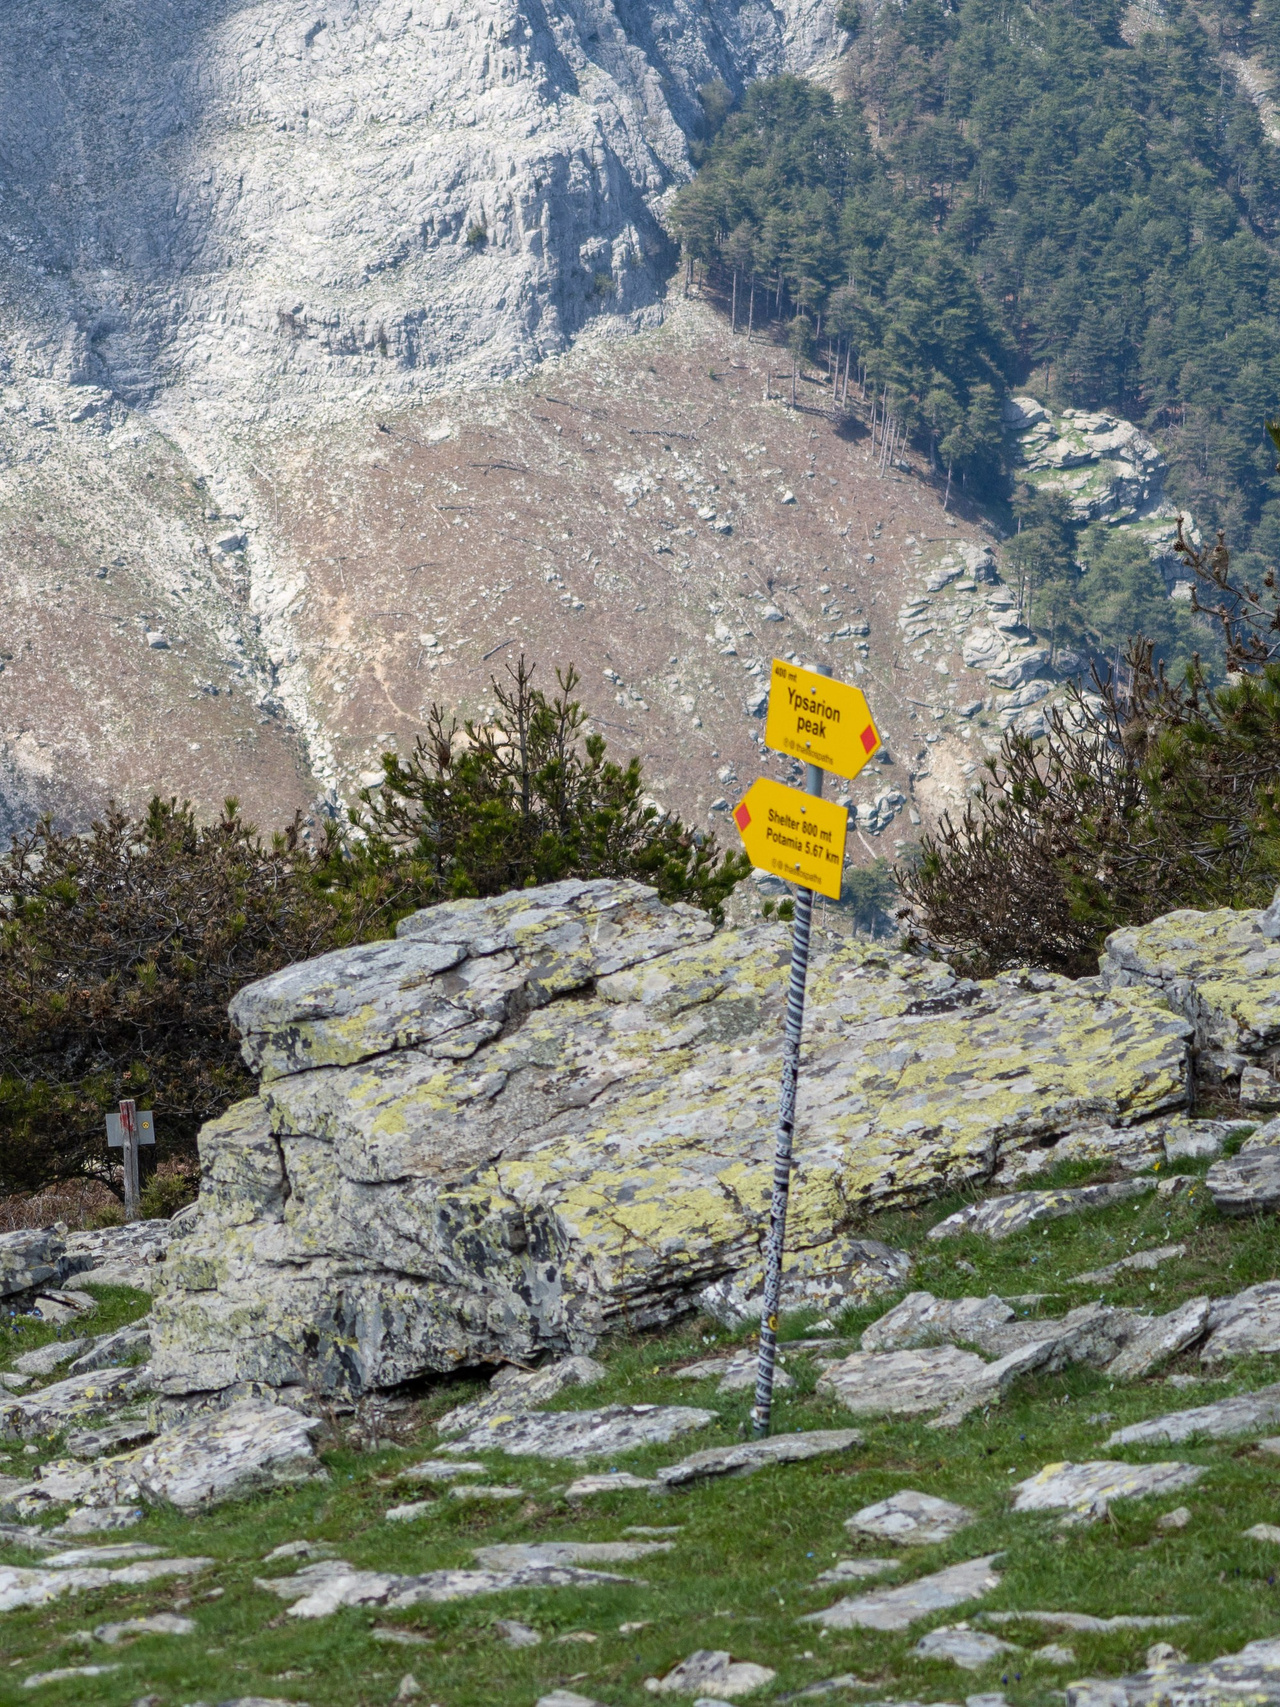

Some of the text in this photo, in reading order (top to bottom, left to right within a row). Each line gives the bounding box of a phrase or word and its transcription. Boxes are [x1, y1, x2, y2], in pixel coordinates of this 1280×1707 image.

[788, 687, 840, 723] Ypsarion
[797, 717, 826, 738] peak
[768, 809, 800, 831] Shelter
[820, 830, 832, 843] mt
[766, 827, 839, 865] Potamia 5.67 km
